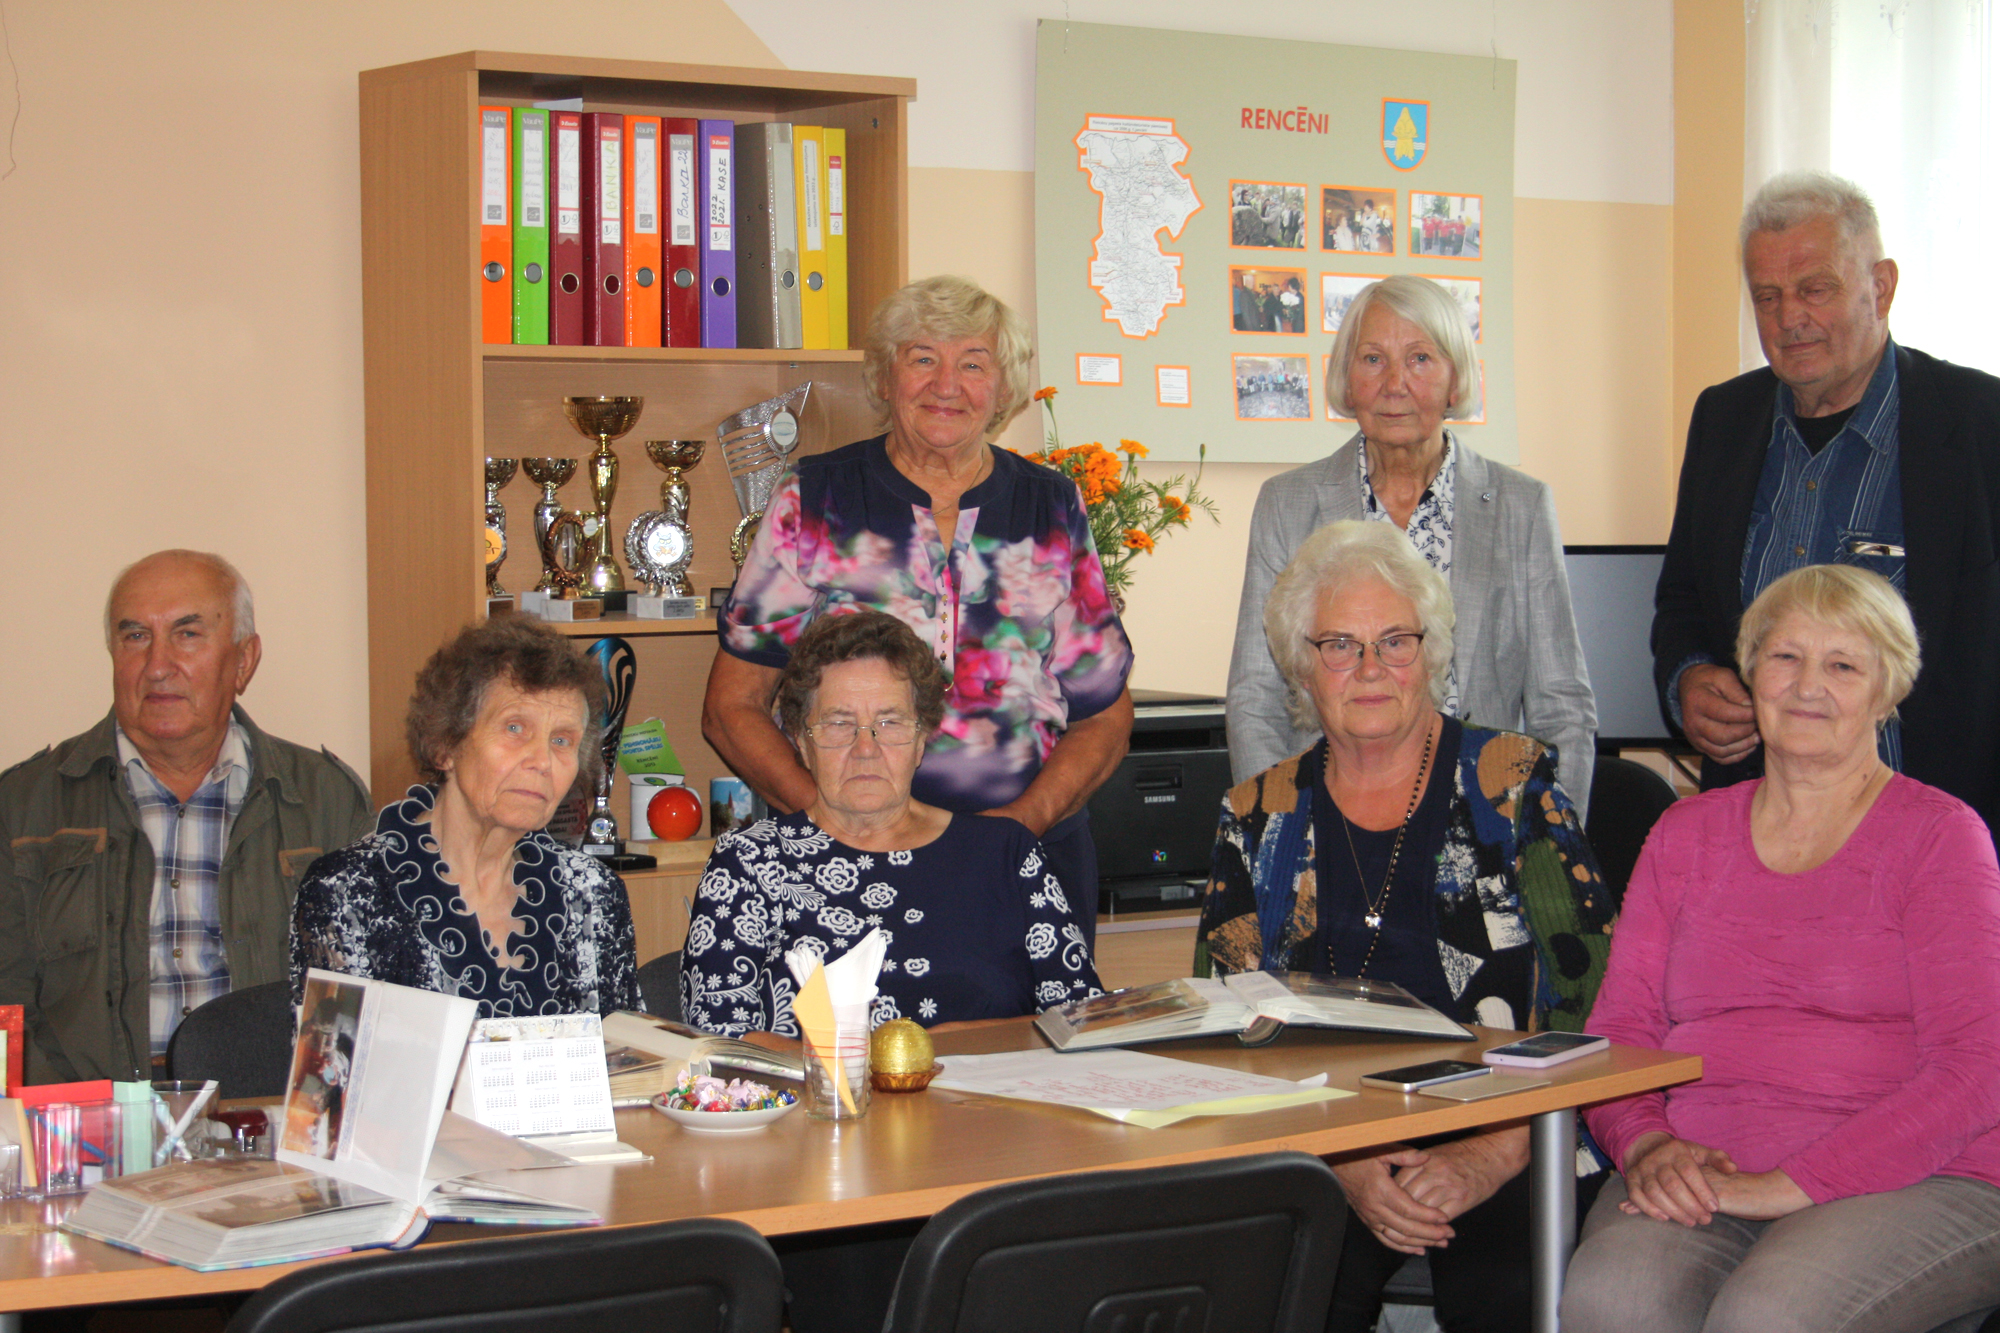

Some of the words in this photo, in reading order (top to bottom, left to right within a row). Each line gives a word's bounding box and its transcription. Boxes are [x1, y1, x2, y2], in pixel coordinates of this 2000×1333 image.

[1241, 105, 1329, 135] RENCĒNI
[604, 141, 619, 212] BANKA
[717, 157, 727, 192] KASE
[1144, 794, 1176, 803] SAMSUNG
